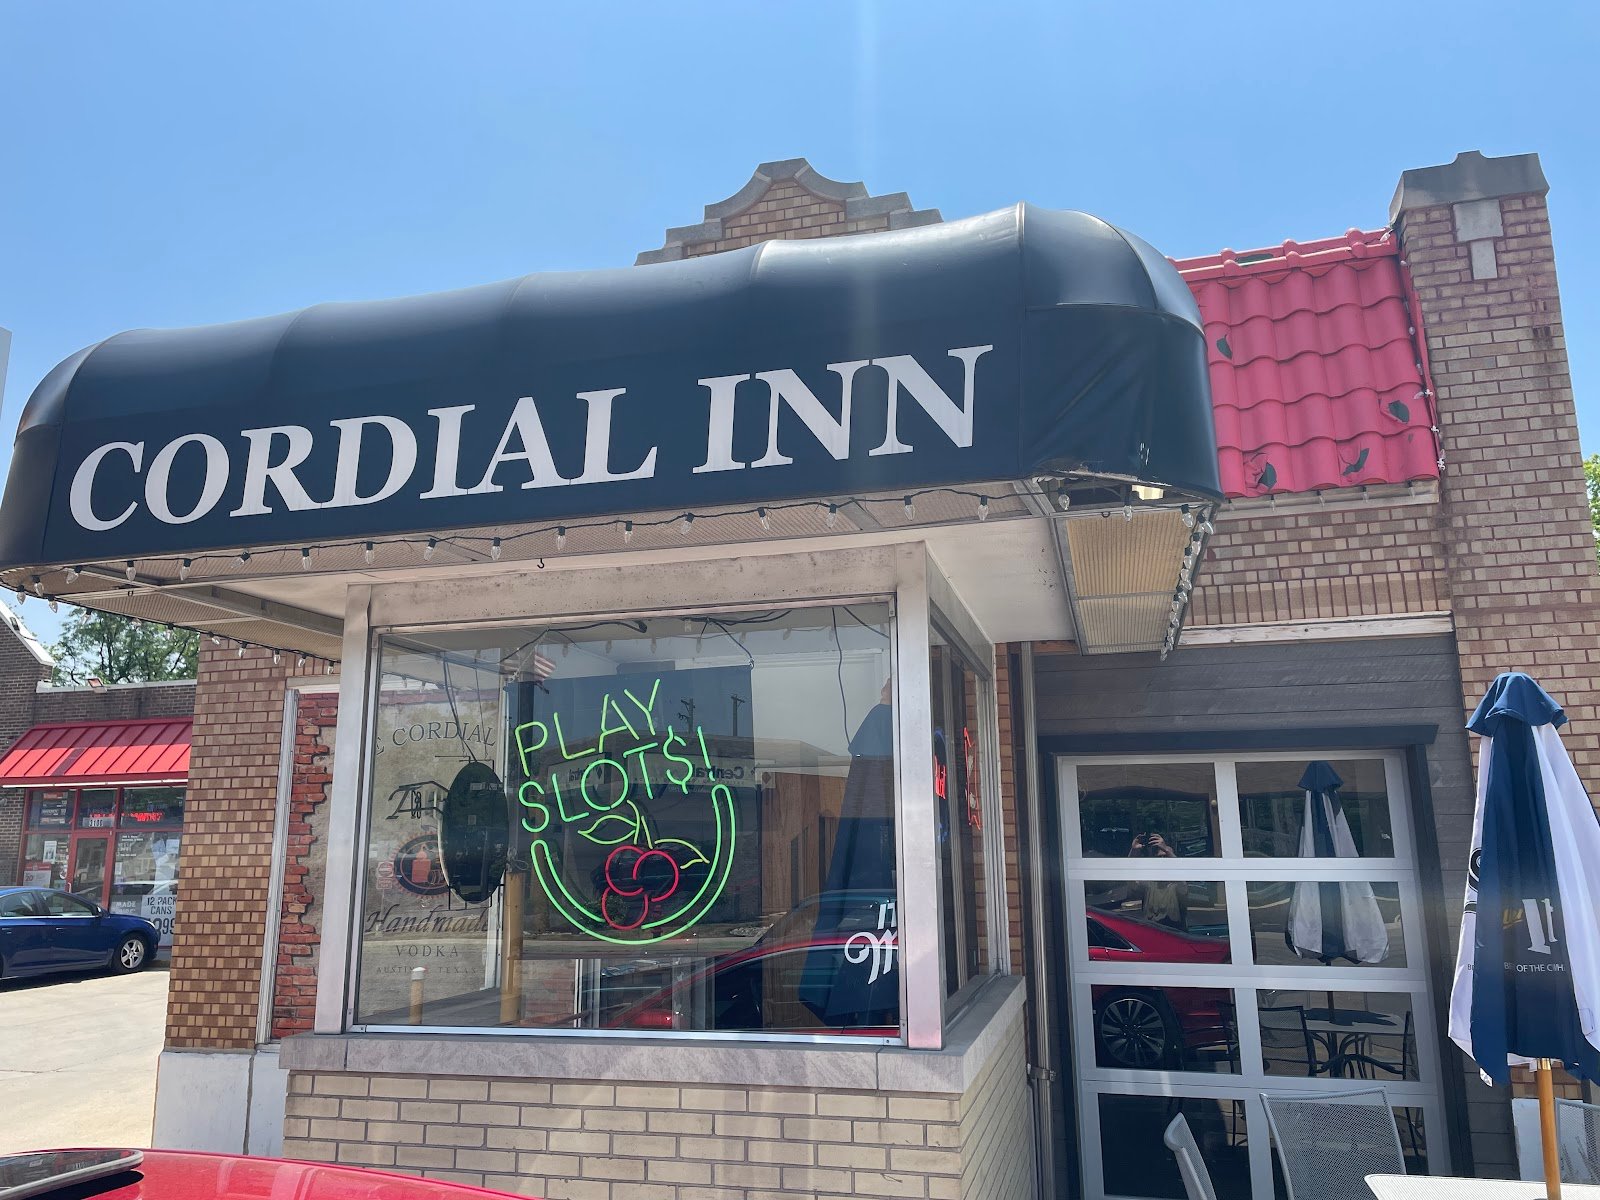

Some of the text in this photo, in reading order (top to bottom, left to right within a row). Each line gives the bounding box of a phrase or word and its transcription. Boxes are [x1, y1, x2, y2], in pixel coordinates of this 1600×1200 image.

[69, 344, 993, 531] CORDIAL INN
[515, 679, 661, 777] PLAY
[392, 721, 497, 747] CORDIAL
[147, 896, 155, 906] 12
[150, 906, 172, 915] CANS
[396, 945, 459, 957] VODKA
[439, 966, 477, 974] TEXAS
[1516, 964, 1528, 973] OF
[1528, 963, 1546, 973] THE
